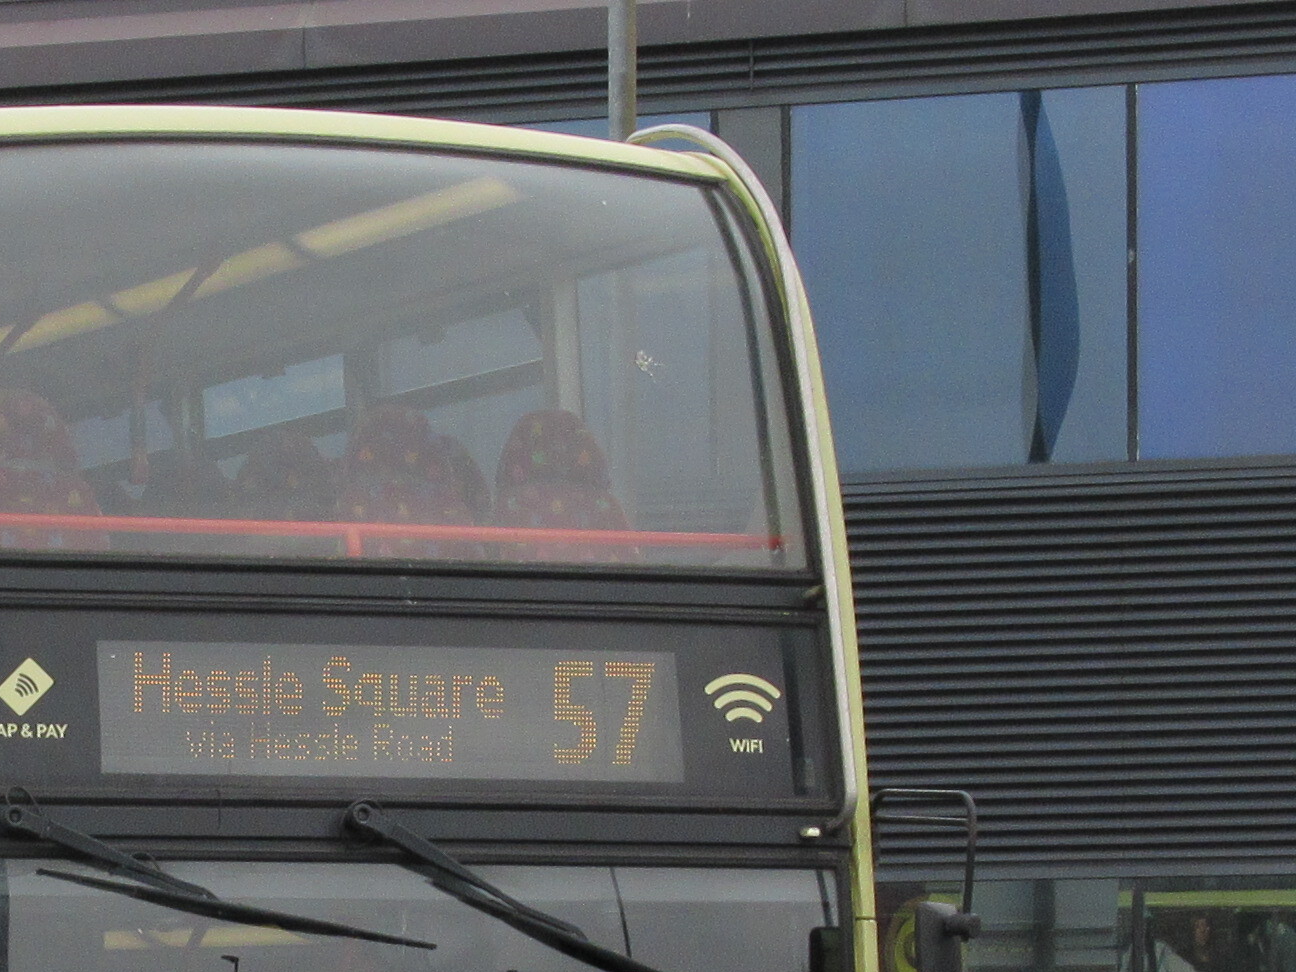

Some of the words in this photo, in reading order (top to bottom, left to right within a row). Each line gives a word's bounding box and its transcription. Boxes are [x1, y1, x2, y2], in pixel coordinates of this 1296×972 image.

[133, 651, 303, 716] Hessle
[322, 656, 504, 719] Square
[20, 722, 34, 739] &
[36, 723, 69, 739] PAY
[553, 661, 656, 766] 57
[186, 721, 236, 760] via
[250, 722, 359, 761] Hessle
[372, 723, 454, 762] Road
[729, 737, 764, 754] WIFI
